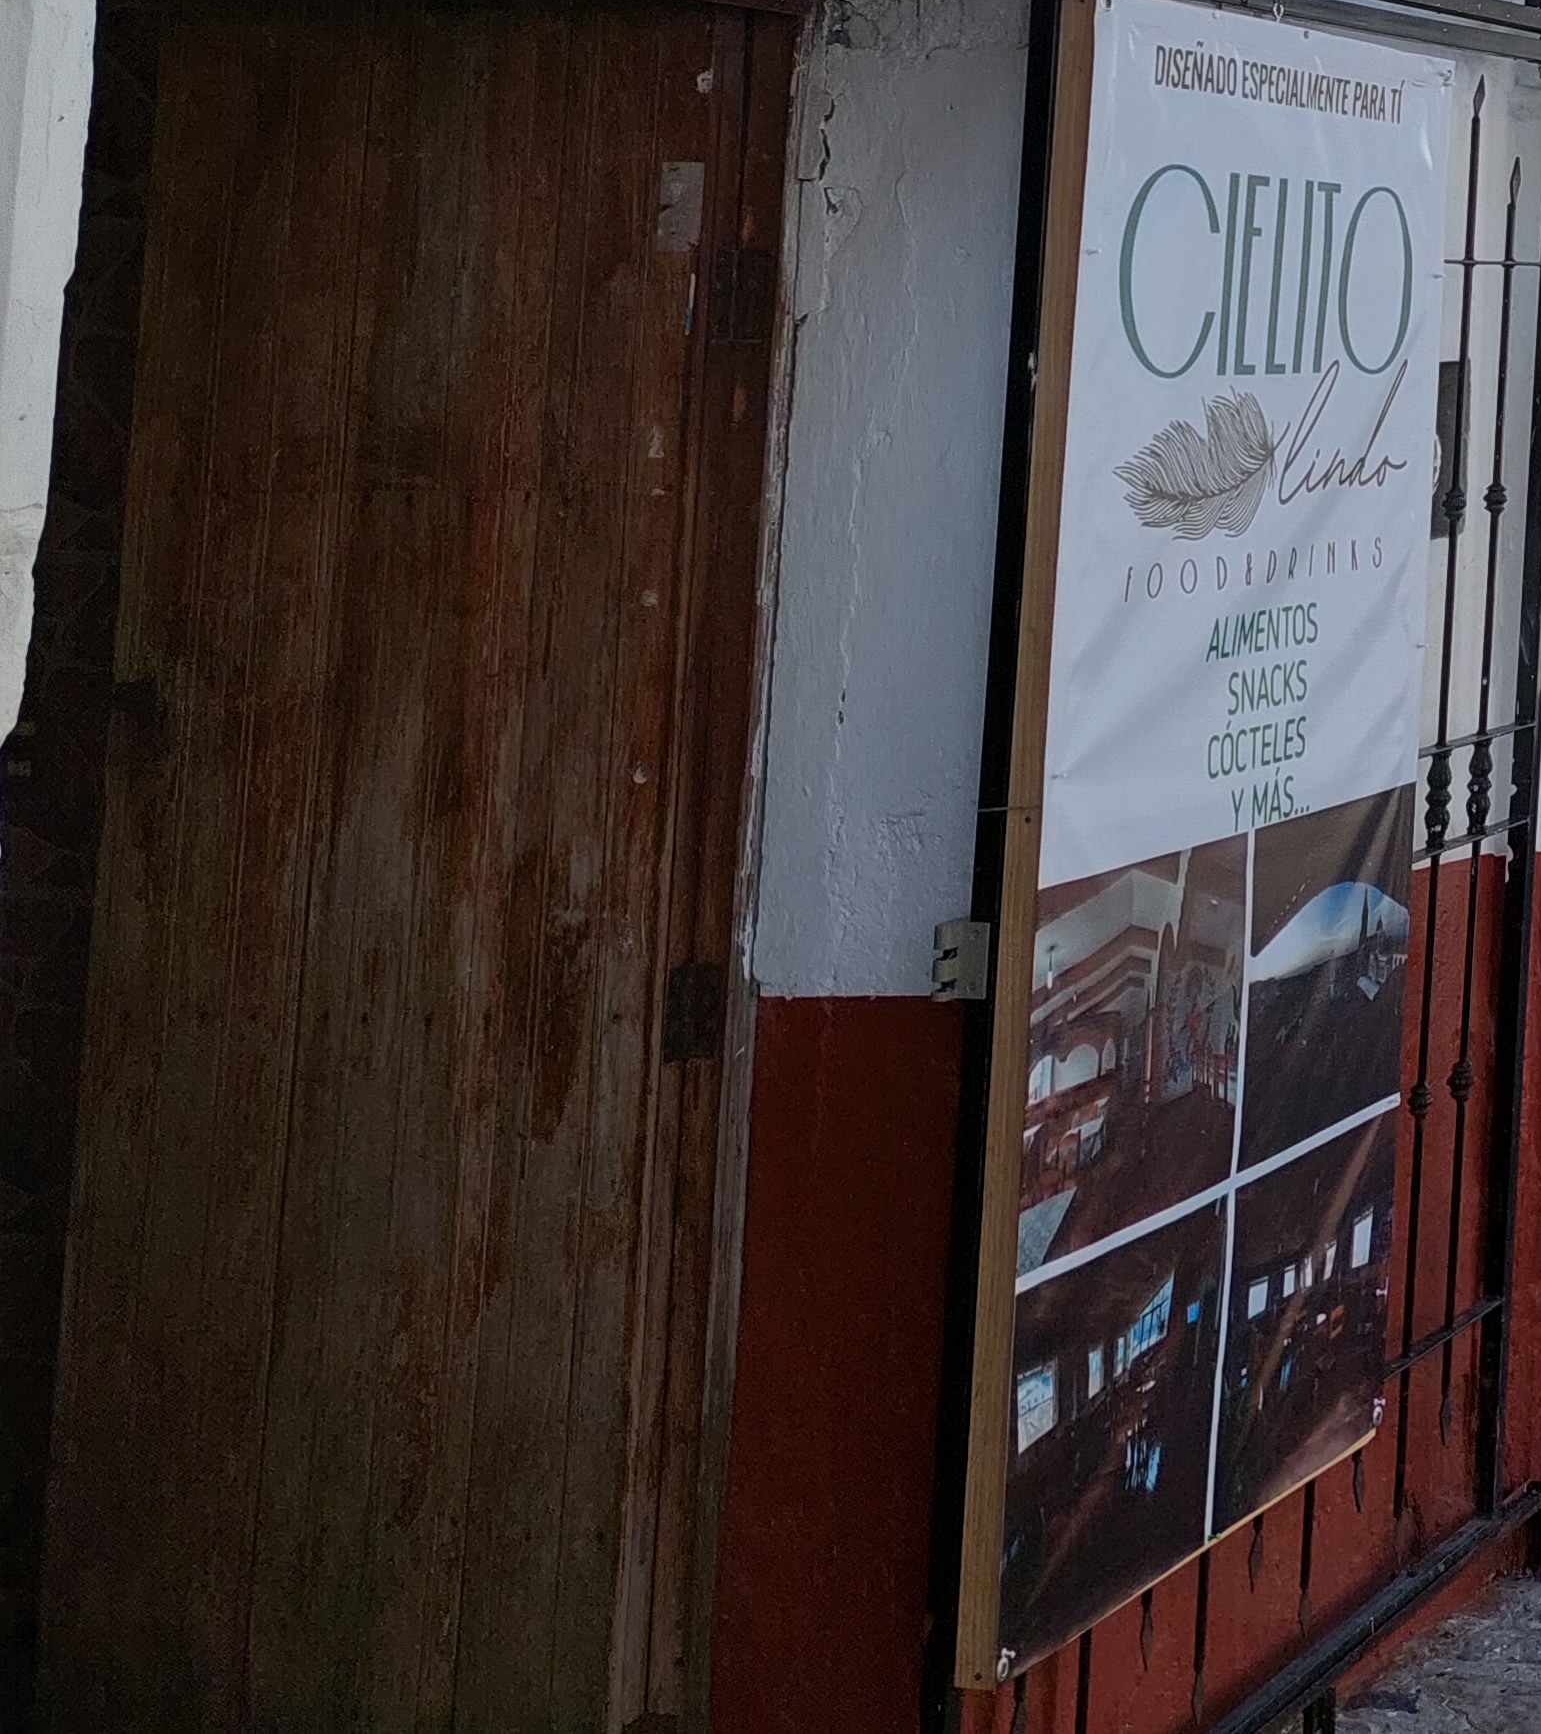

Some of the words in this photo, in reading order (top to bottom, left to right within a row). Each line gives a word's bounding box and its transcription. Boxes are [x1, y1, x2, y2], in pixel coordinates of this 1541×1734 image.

[1154, 41, 1238, 97] DISEÑADO
[1242, 60, 1351, 116] ESPECIALMENTE
[1352, 81, 1386, 122] PARA
[1390, 79, 1405, 125] TÍ
[1119, 164, 1413, 379] CIELITO
[1278, 358, 1408, 505] lindo
[1206, 602, 1319, 663] ALIMENTOS
[1228, 659, 1308, 716] SNACKS
[1207, 715, 1307, 780] CÓCTELES
[1231, 787, 1245, 833] Y
